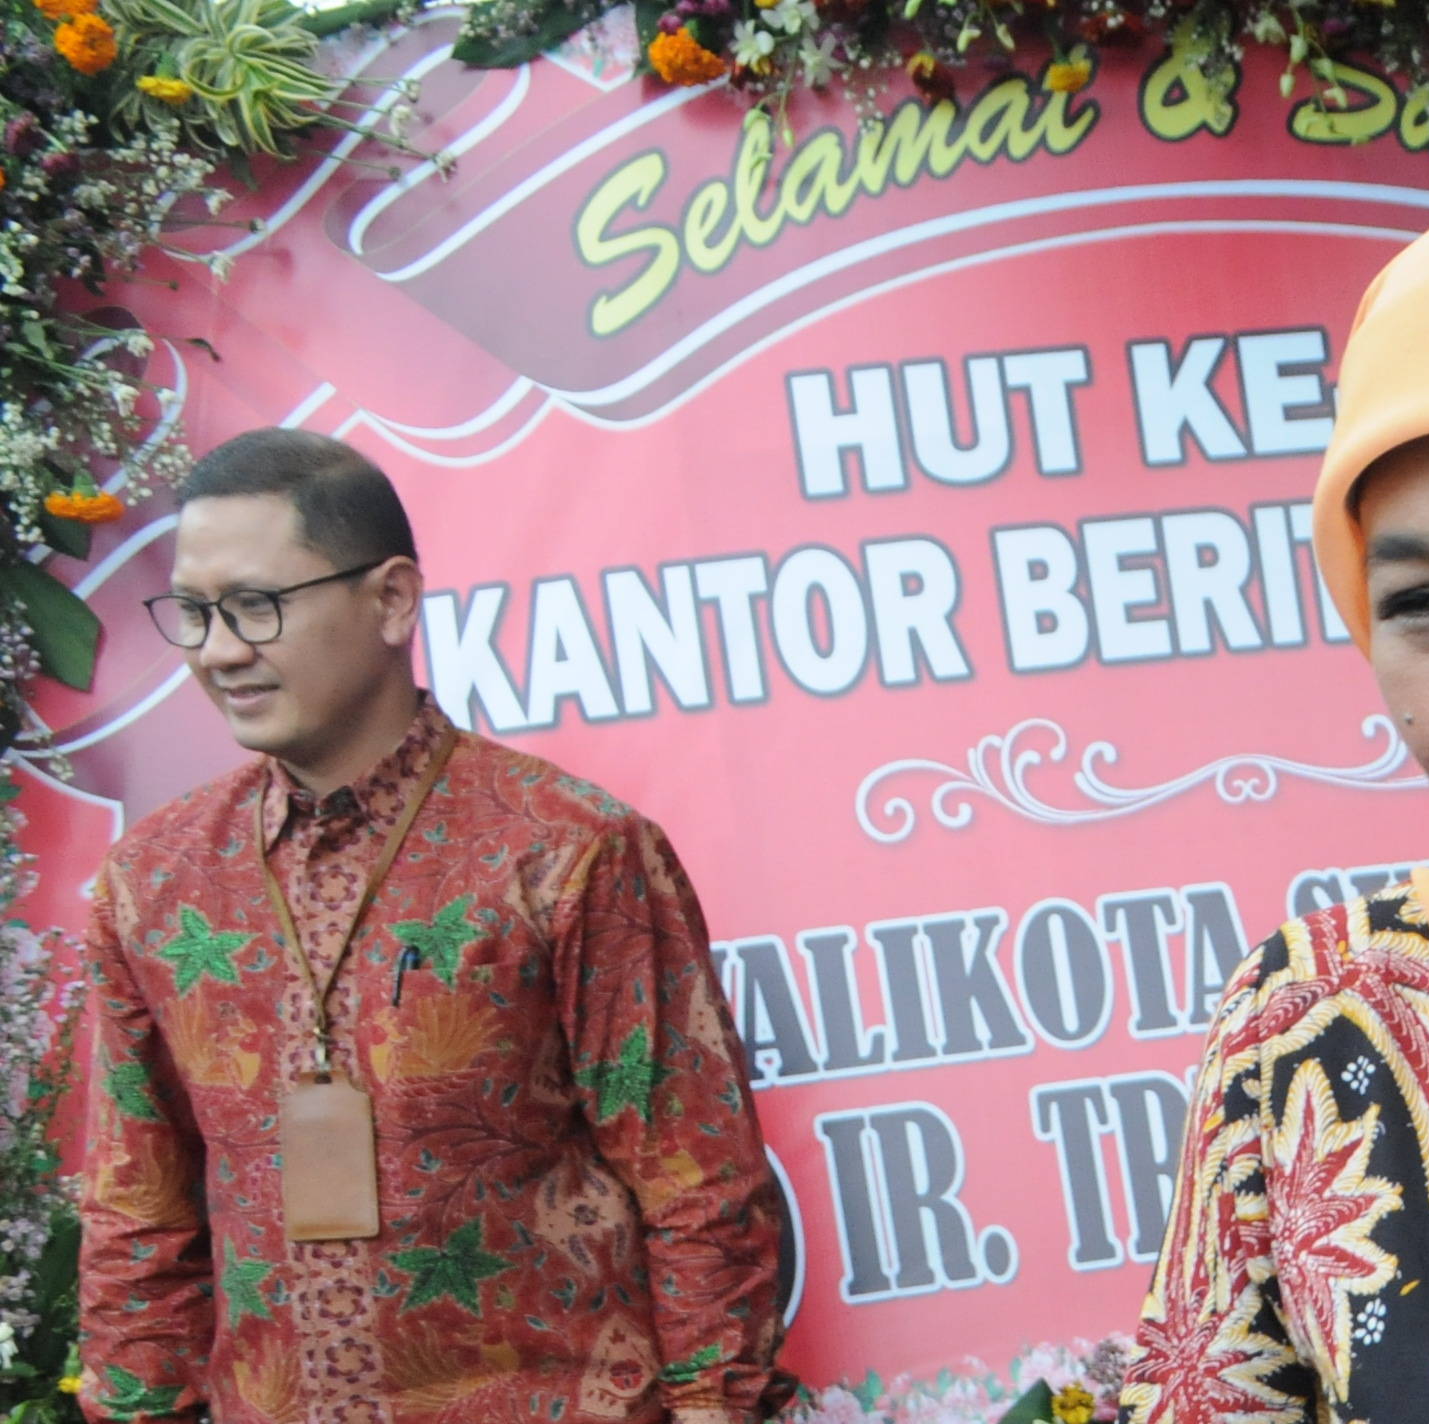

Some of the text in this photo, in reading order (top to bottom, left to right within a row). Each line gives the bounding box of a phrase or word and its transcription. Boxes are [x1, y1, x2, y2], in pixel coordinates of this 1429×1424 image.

[788, 329, 1335, 498] HUT KE
[423, 536, 972, 733] KANTOR
[710, 880, 1247, 1086] ALIKOTA
[816, 1070, 1200, 1303] IR. TR
